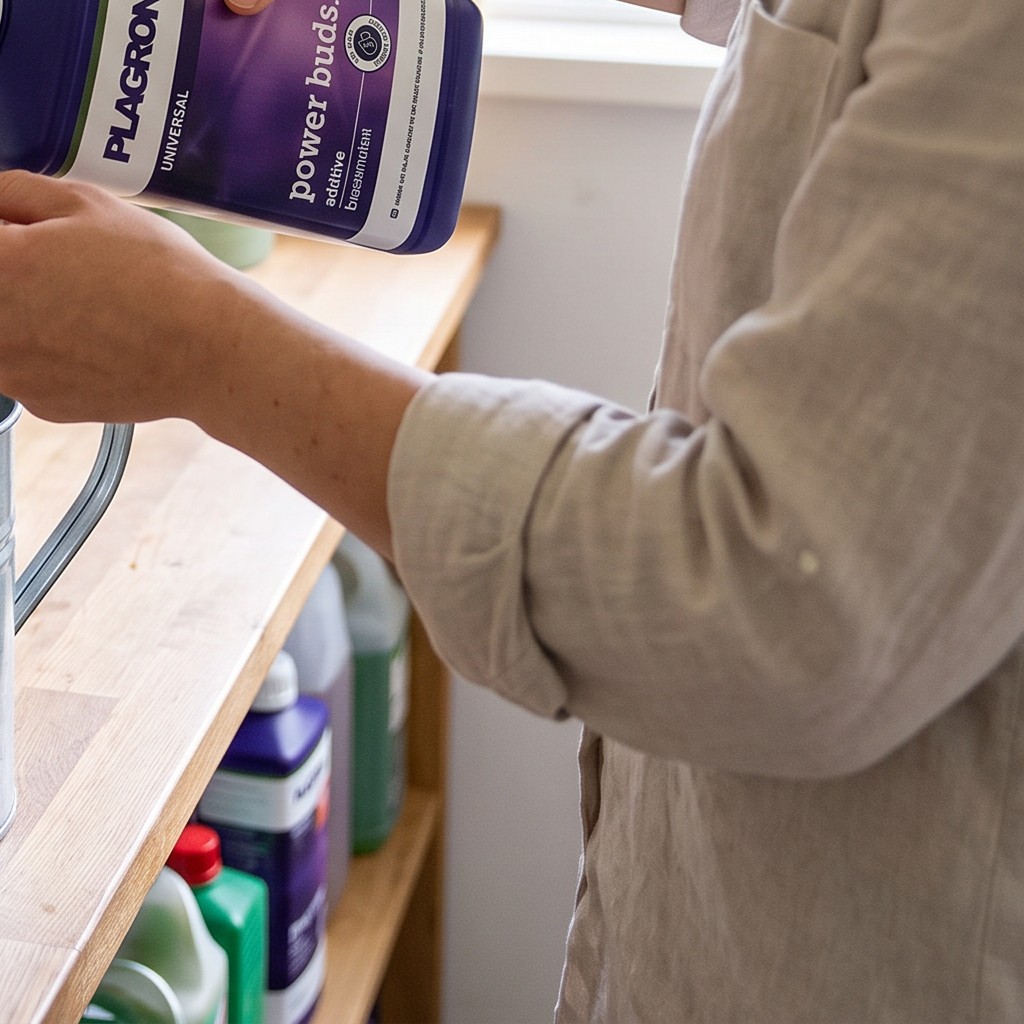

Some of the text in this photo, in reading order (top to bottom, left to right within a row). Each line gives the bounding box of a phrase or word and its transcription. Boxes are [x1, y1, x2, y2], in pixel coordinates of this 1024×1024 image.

[161, 90, 189, 171] UNIVERSAL
[289, 0, 340, 204] power buds.
